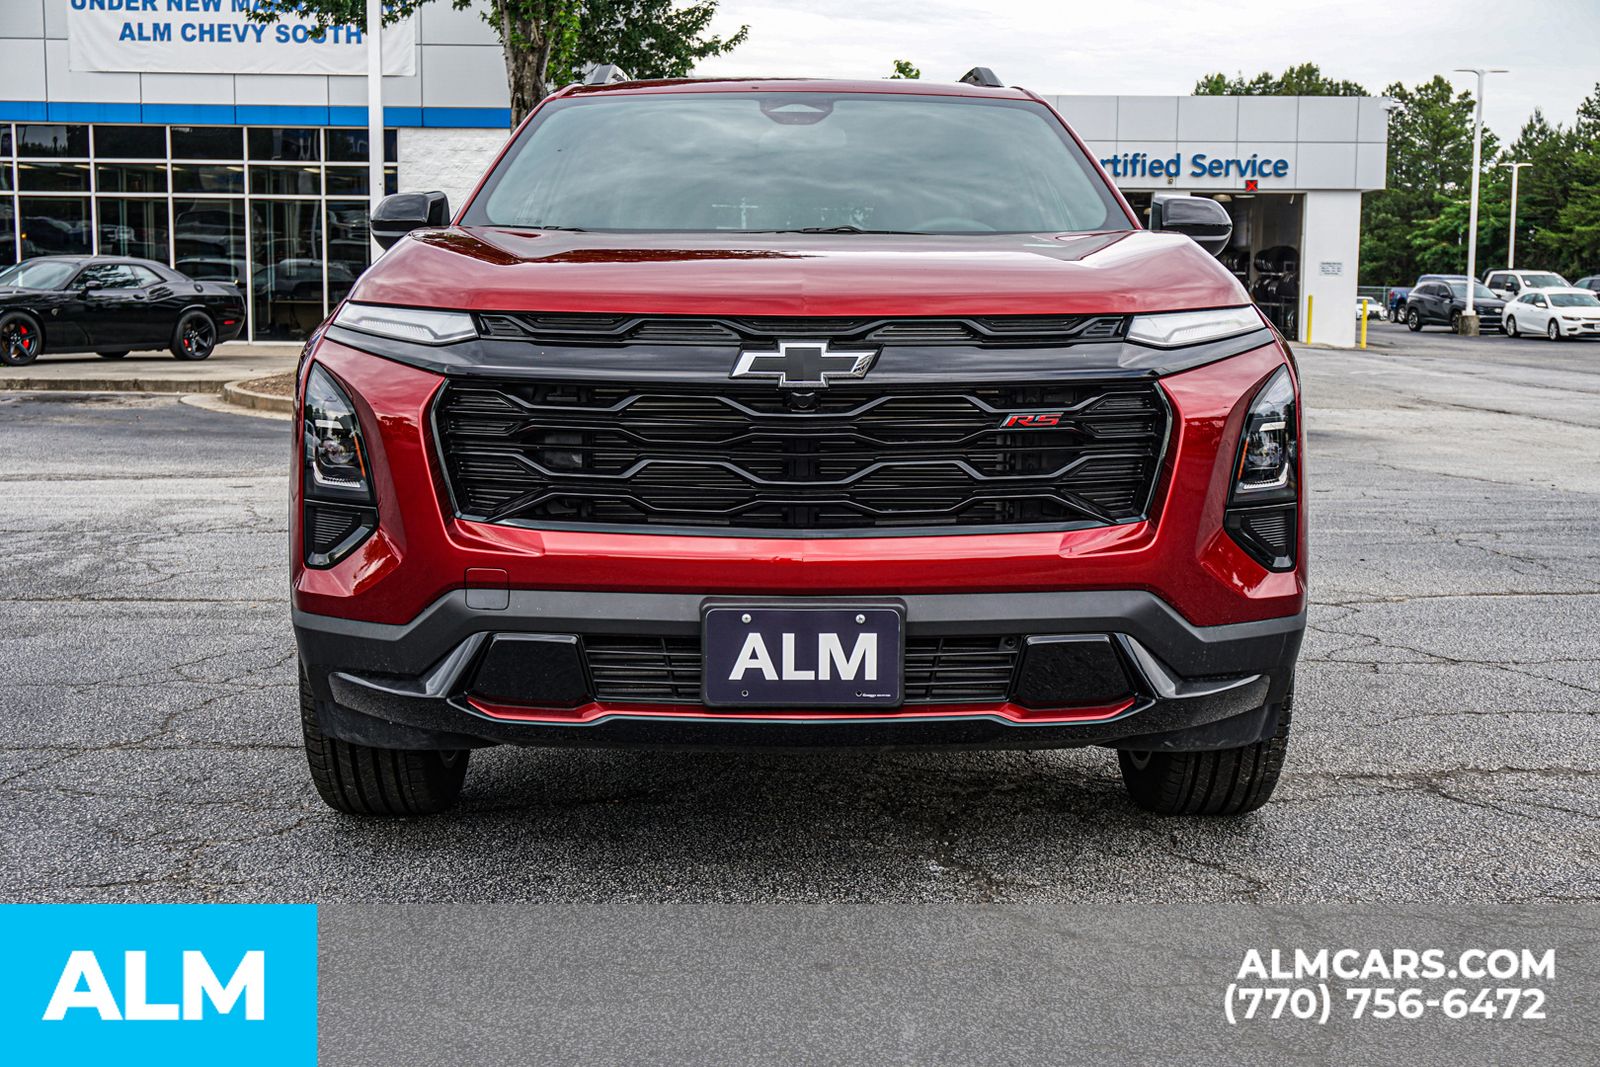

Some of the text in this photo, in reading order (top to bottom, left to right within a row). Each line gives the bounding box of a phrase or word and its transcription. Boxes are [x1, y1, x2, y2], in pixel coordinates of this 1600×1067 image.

[167, 0, 222, 12] NEW
[119, 22, 172, 42] ALM
[180, 23, 267, 44] CHEVY
[1100, 153, 1290, 177] rtified Service
[1003, 414, 1062, 427] RS
[728, 632, 878, 681] ALM
